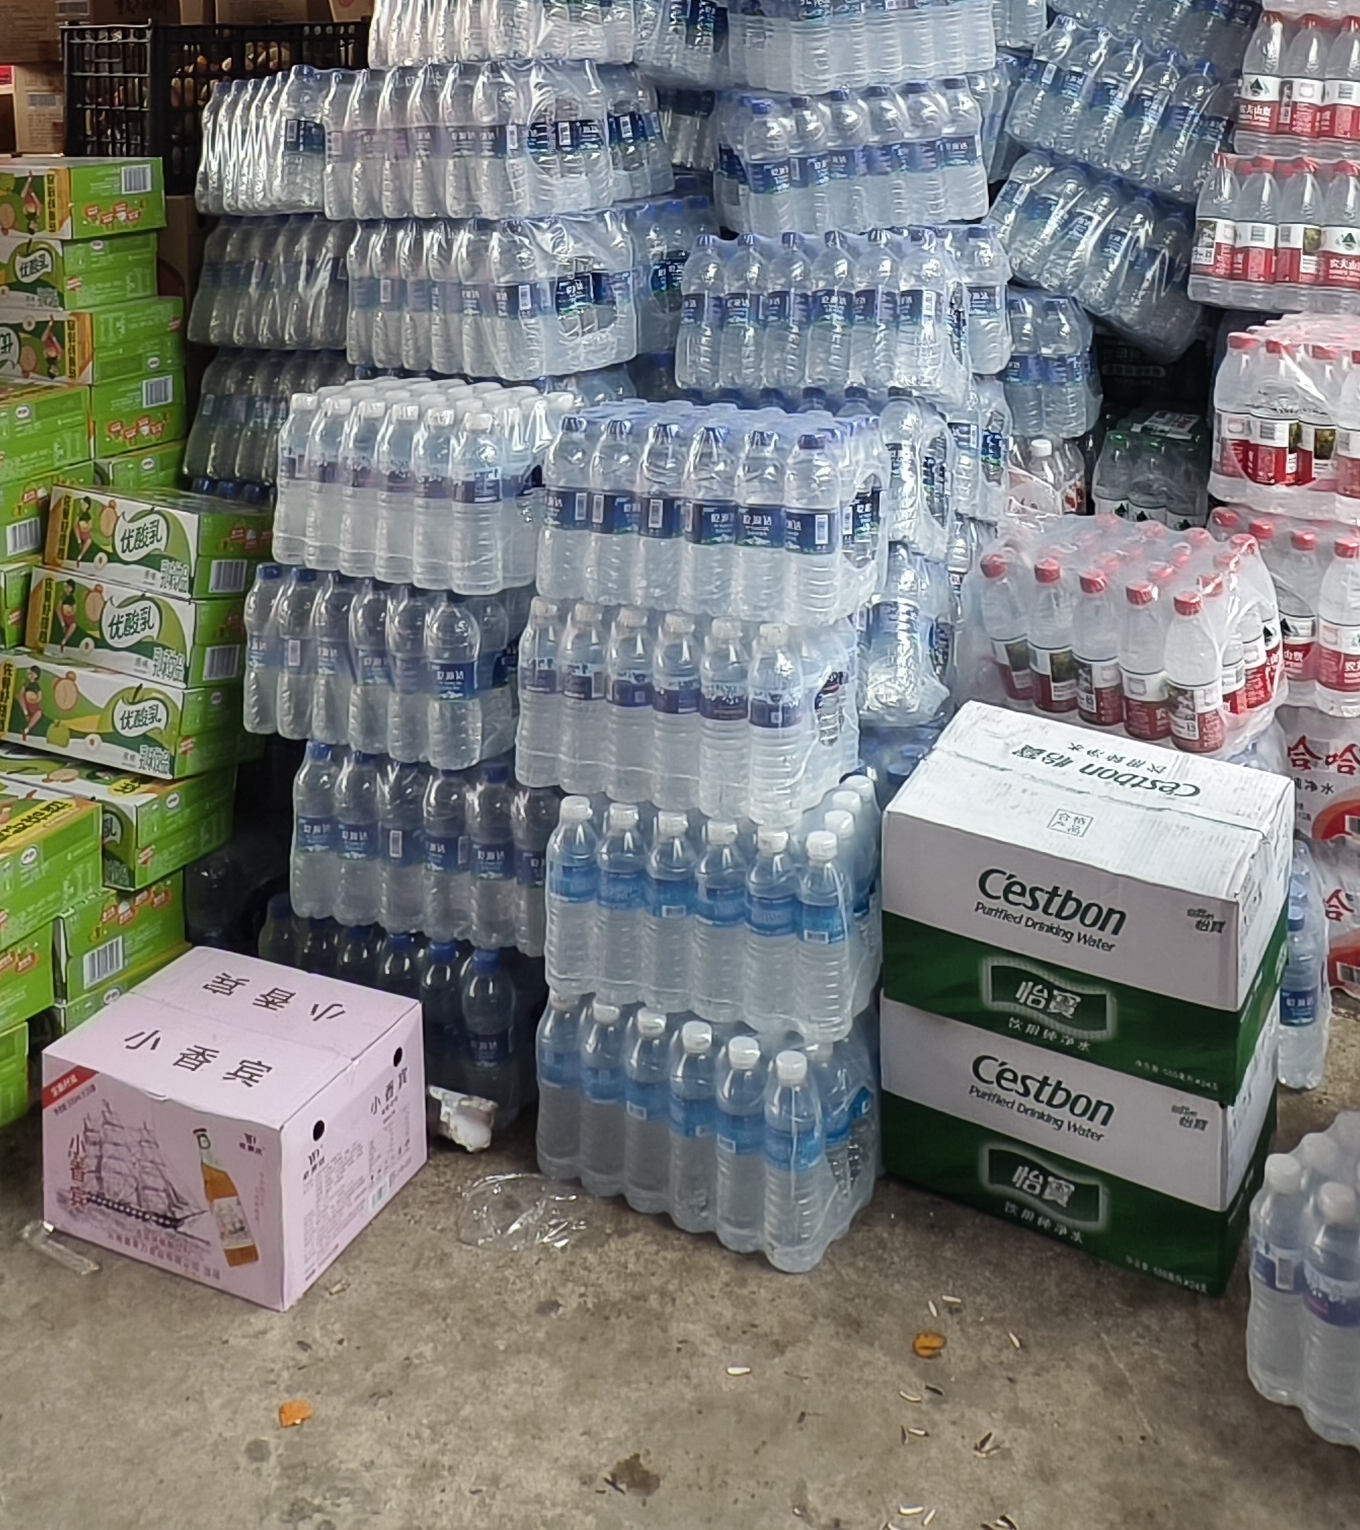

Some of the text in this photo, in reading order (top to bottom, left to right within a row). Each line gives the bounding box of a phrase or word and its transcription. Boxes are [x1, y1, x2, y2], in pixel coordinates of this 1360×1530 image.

[119, 518, 164, 553] 优酸乳
[108, 606, 156, 640] 优酸乳
[118, 703, 163, 730] 优酸乳
[974, 901, 1116, 953] Purified Drinking Water
[978, 868, 1127, 937] C'estbon
[124, 1029, 273, 1088] 小香宾
[1008, 1016, 1092, 1052] 饮用纯净水
[968, 1085, 1105, 1143] Purified Drinking Water
[971, 1054, 1116, 1127] C'estbon
